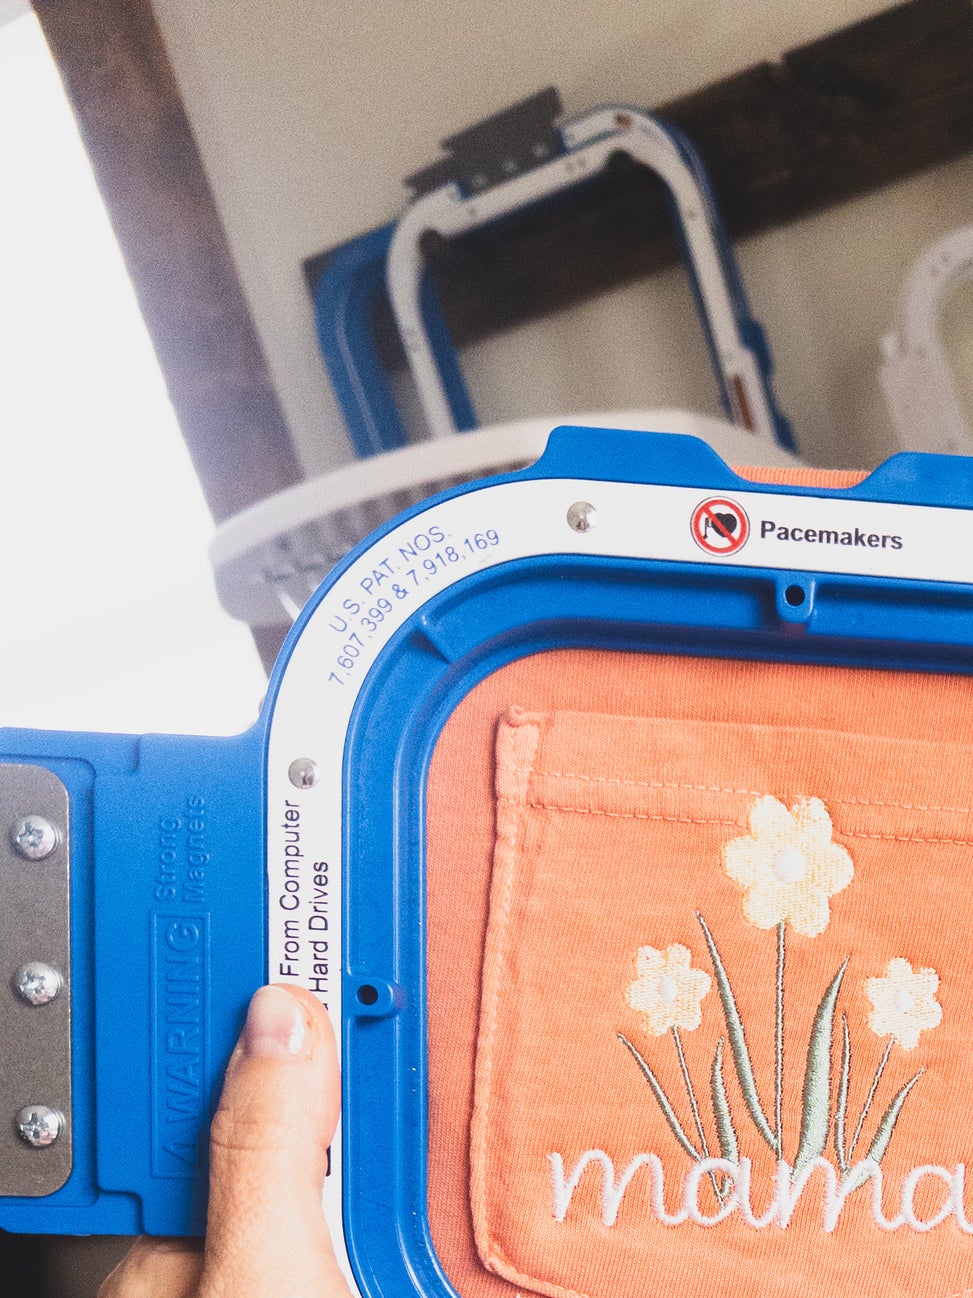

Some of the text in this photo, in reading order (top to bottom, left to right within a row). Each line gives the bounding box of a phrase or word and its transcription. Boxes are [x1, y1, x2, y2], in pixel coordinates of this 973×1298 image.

[328, 525, 453, 633] U.S. PAT. NOS.
[760, 519, 904, 550] Pacemakers
[327, 528, 501, 686] 7,607,399 & 7,918,169
[154, 816, 184, 901] Strong
[182, 797, 212, 904] Magnets
[279, 799, 305, 979] From Computer
[308, 860, 330, 930] Drives
[308, 940, 330, 995] Hard
[164, 918, 202, 1126] WARNING
